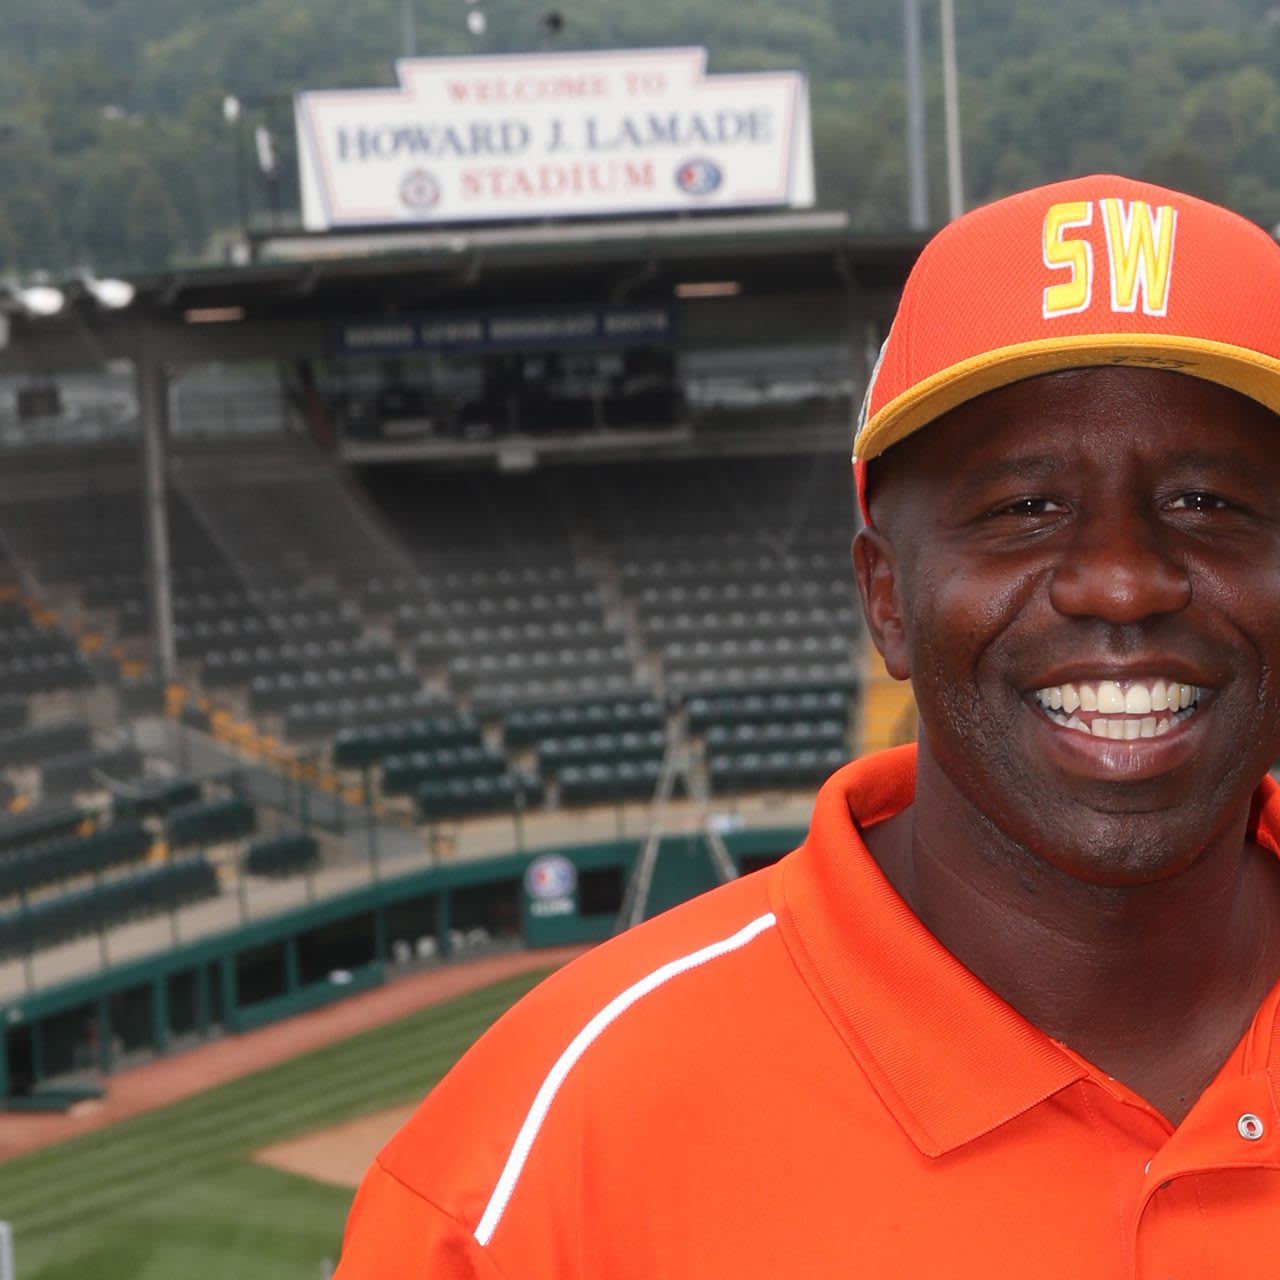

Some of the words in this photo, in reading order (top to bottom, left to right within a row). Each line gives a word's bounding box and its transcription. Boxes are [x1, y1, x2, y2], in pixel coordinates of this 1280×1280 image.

[446, 72, 615, 104] WELCOME
[624, 70, 668, 97] TO
[336, 120, 530, 161] HOWARD
[545, 119, 573, 153] J.
[586, 108, 773, 150] LAMADE
[459, 159, 655, 199] STADIUM
[1042, 198, 1178, 320] SW
